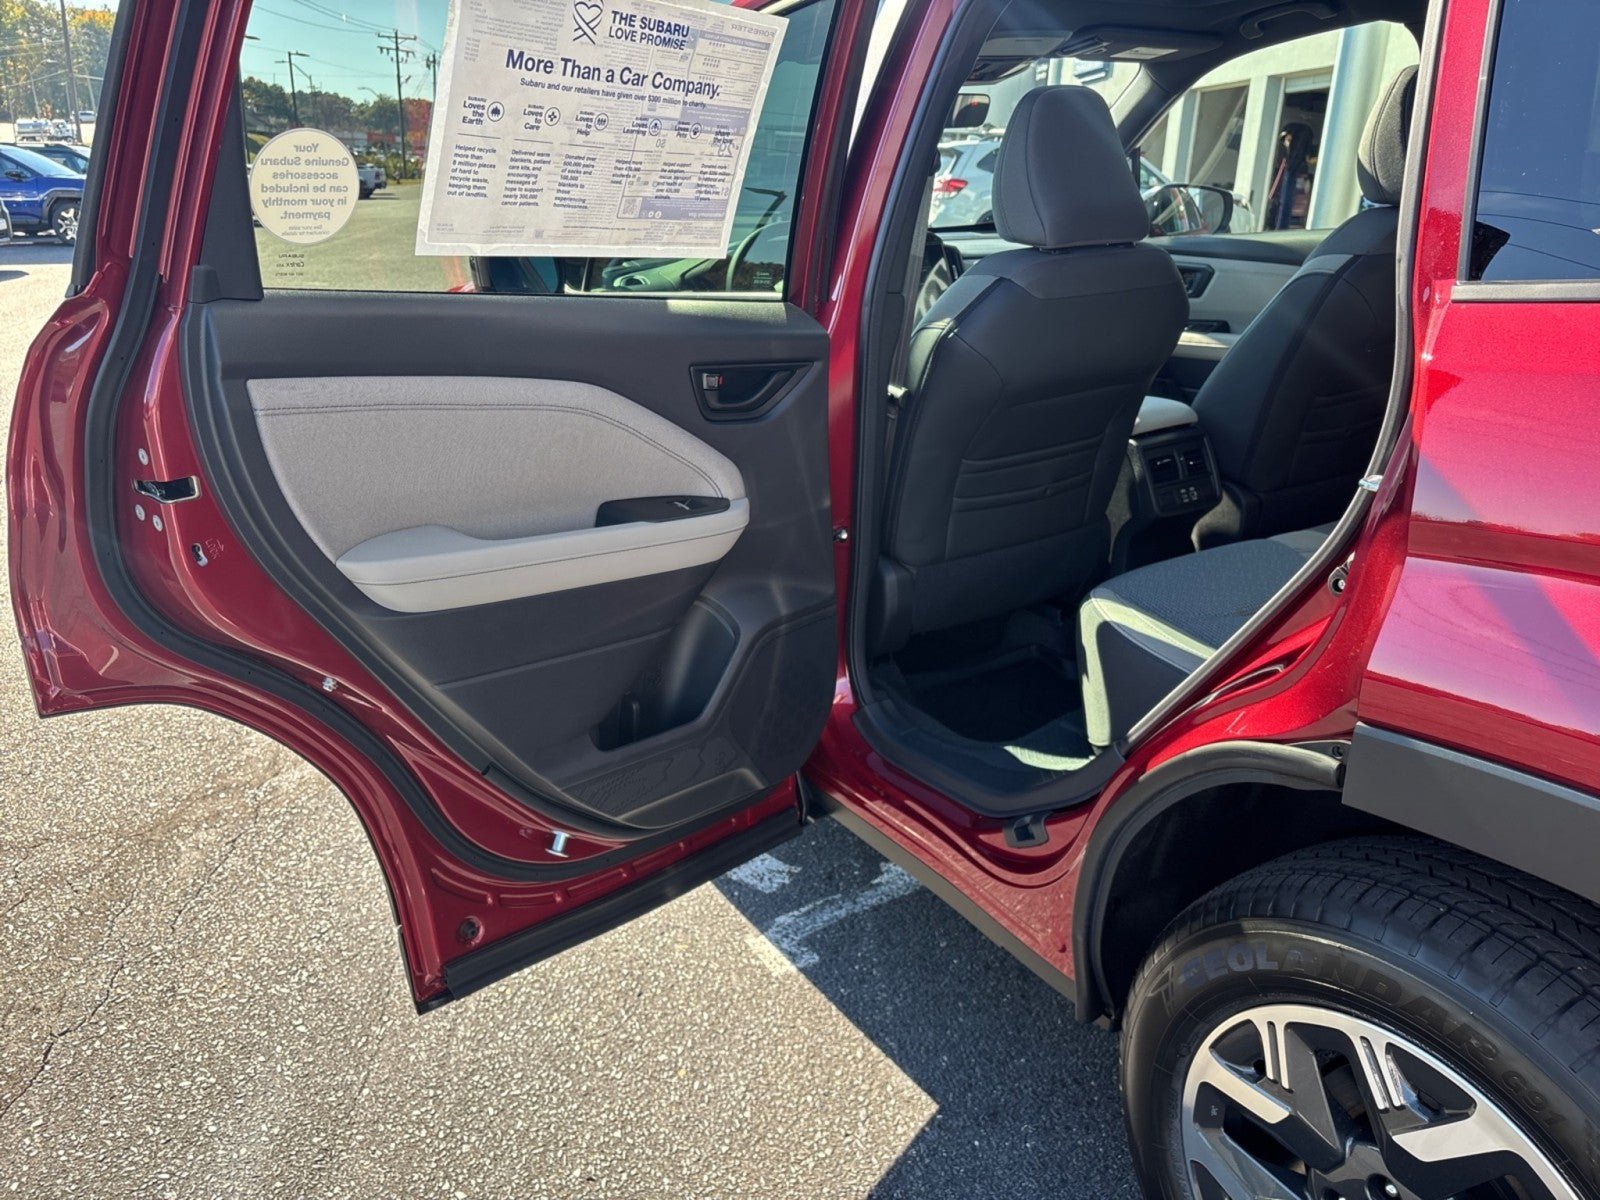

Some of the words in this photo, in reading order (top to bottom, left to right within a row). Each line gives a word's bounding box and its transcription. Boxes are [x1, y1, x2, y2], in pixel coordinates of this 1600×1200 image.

[612, 11, 636, 27] THE
[640, 17, 689, 38] SUBARU
[609, 27, 637, 42] LOVE
[640, 34, 687, 50] PROMISE
[506, 49, 554, 74] More
[561, 57, 600, 81] Than
[606, 69, 615, 82] a
[620, 67, 648, 87] Car
[652, 71, 721, 99] Company.
[520, 78, 545, 88] Subaru
[575, 86, 600, 96] retailers
[602, 89, 615, 98] have
[617, 92, 632, 100] given
[648, 95, 661, 103] $300
[662, 97, 681, 105] million
[463, 101, 485, 110] Loves
[523, 109, 543, 117] Loves
[462, 116, 483, 125] Earth
[575, 115, 593, 123] Loves
[524, 122, 540, 131] Care
[623, 127, 647, 136] Learning
[455, 144, 476, 153] Helped
